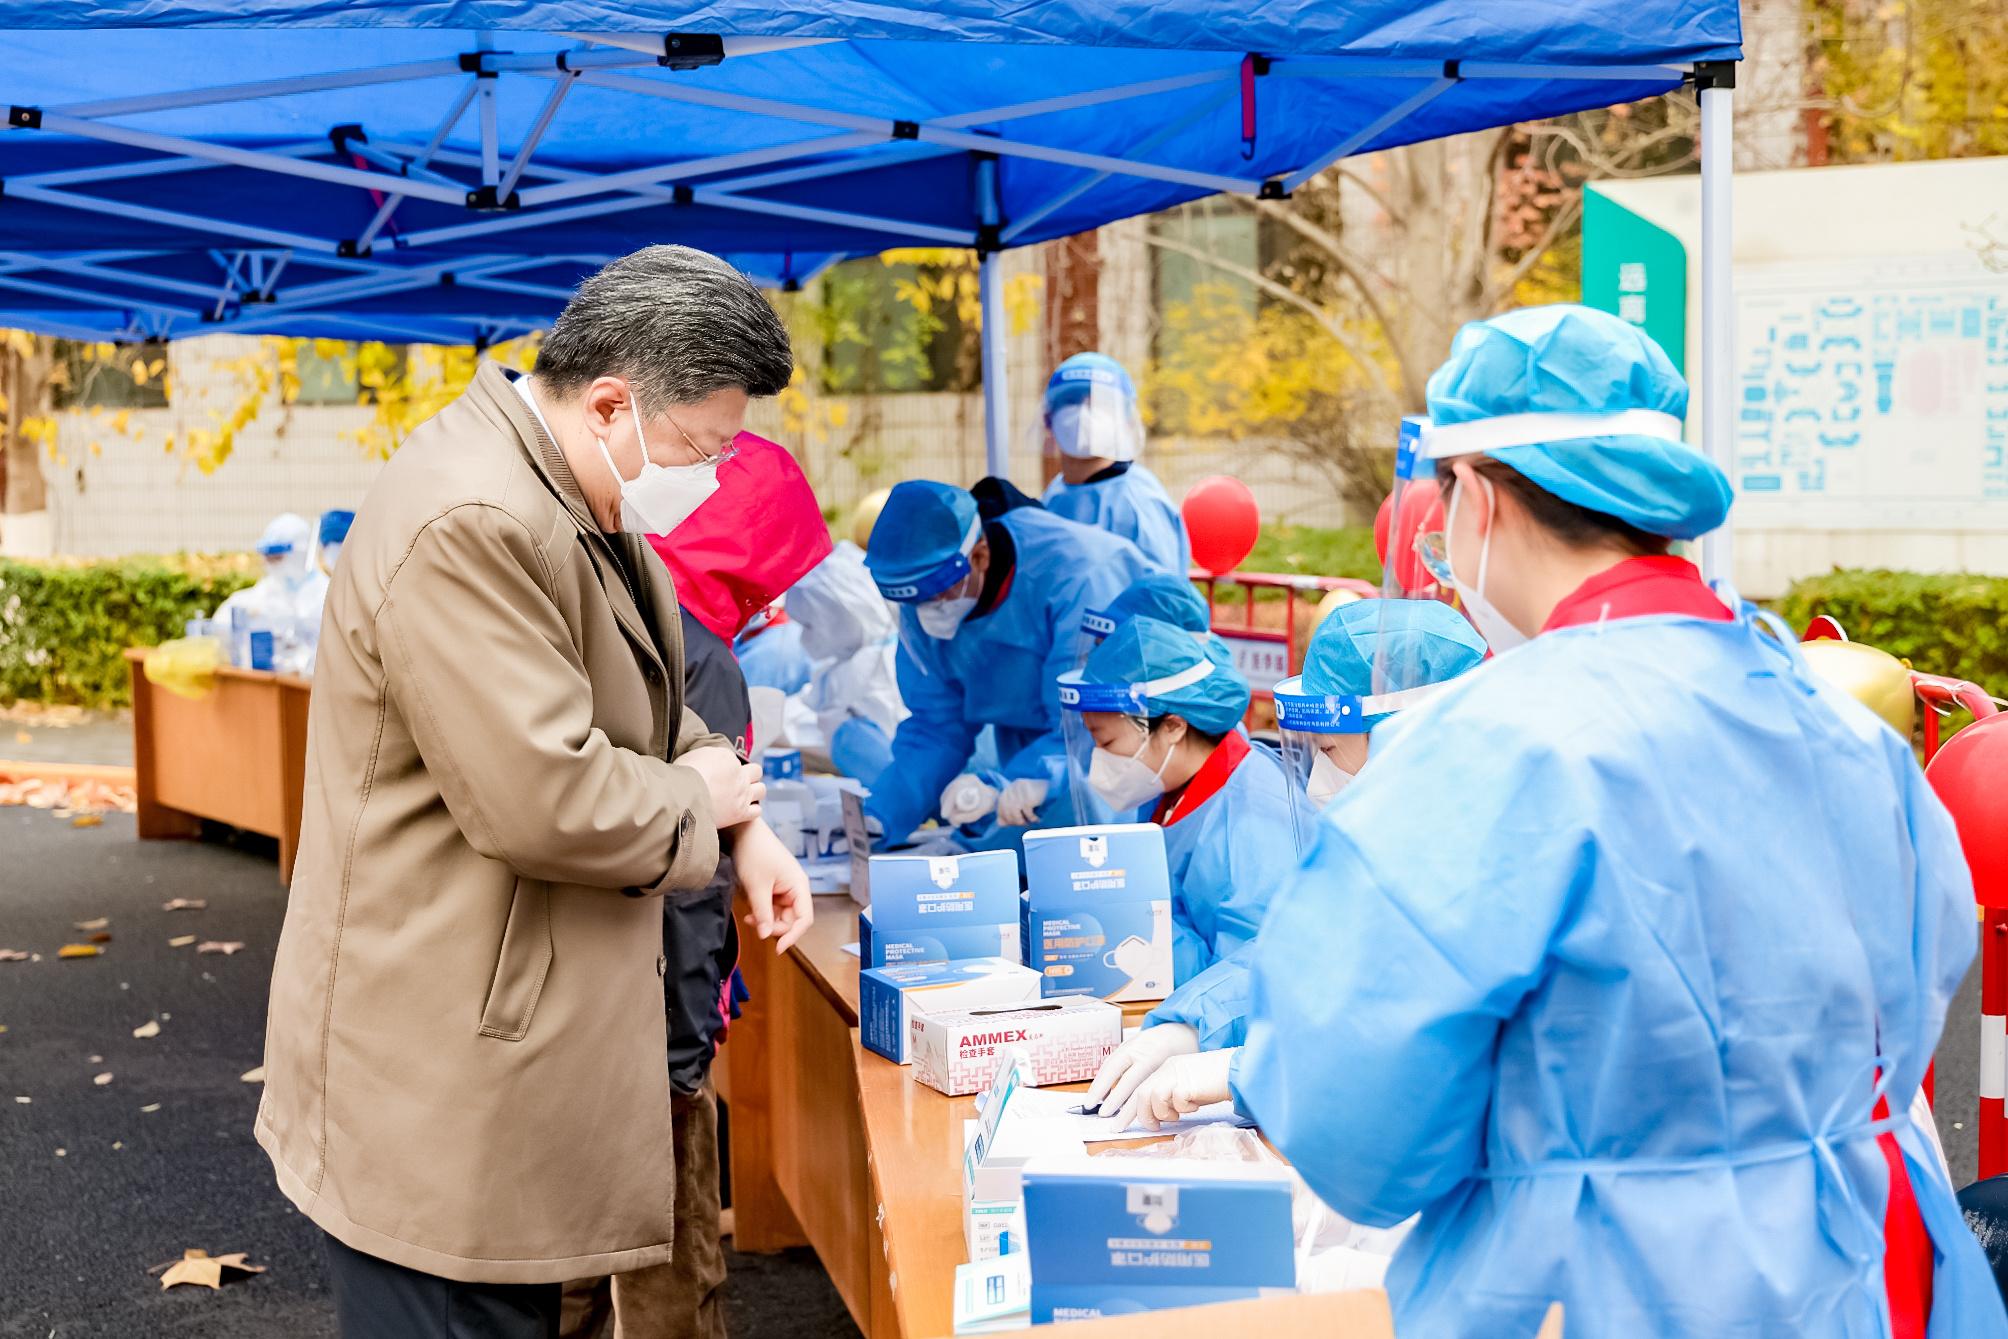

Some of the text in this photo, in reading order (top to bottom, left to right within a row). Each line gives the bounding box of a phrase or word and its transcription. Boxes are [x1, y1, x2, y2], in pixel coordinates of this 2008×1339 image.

[959, 1029, 1028, 1047] AMMEX
[959, 1046, 995, 1059] 检查手套
[1102, 1046, 1111, 1057] M
[1053, 1307, 1103, 1318] MEDICAL
